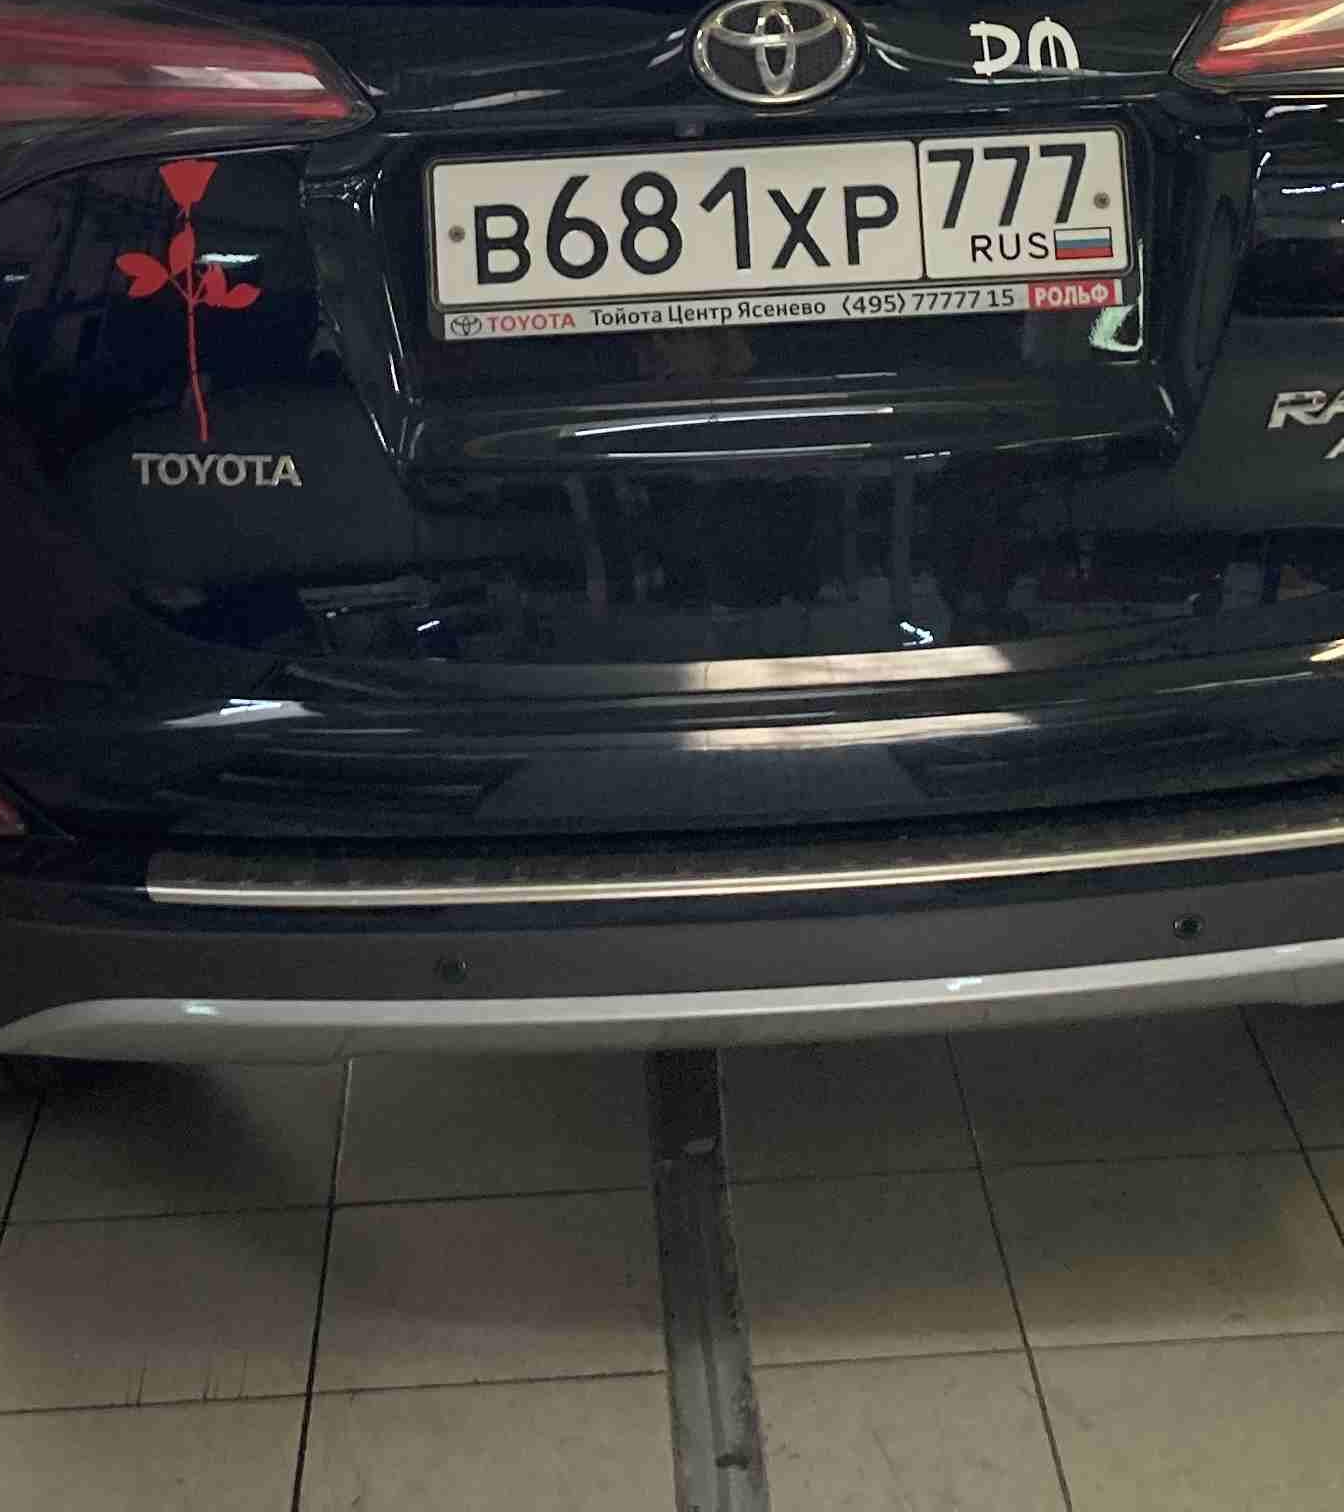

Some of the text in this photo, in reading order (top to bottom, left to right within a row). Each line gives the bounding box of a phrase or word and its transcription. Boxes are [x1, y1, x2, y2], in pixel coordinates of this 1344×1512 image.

[927, 143, 1088, 230] 777
[971, 232, 1049, 263] RUS
[1034, 281, 1110, 307] РОЛЬФ
[486, 312, 576, 333] TOYOTA
[590, 306, 663, 327] Тойота
[667, 302, 733, 325] Центр
[737, 299, 826, 320] Ясенево
[842, 294, 906, 316] (495)
[131, 453, 303, 487] TOYOTA
